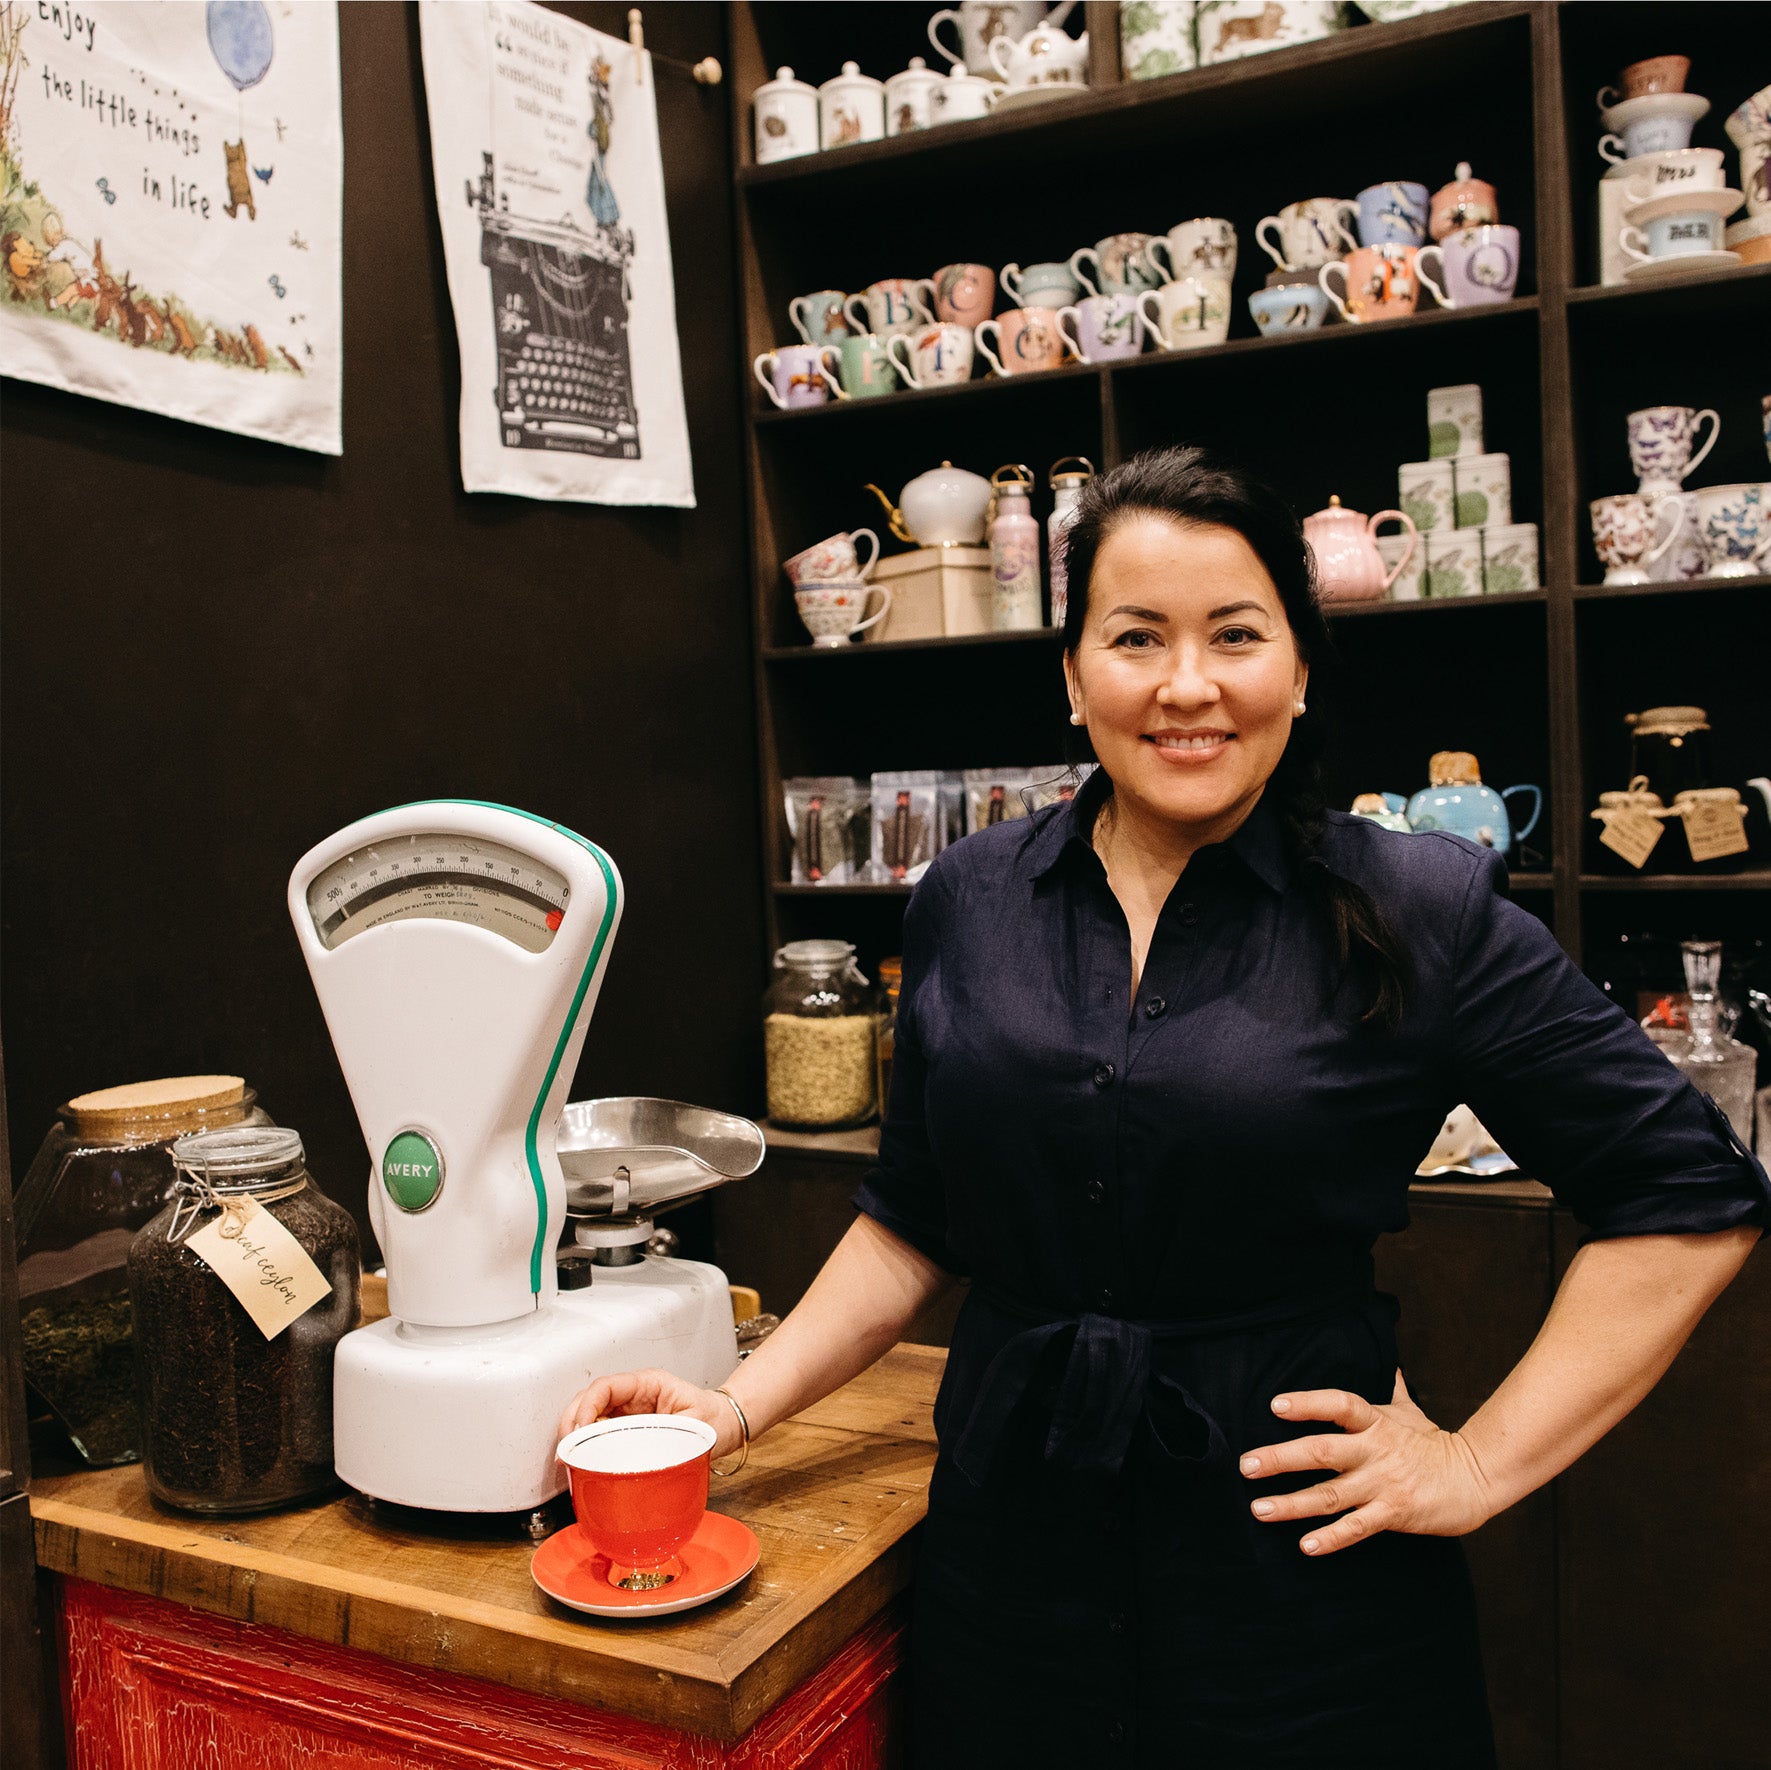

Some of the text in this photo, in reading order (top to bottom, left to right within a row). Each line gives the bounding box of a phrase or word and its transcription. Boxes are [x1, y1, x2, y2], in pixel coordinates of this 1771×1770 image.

[42, 64, 201, 156] the little things
[143, 167, 211, 220] in life
[459, 855, 469, 863] 200
[484, 862, 494, 870] 150
[535, 879, 543, 887] 50
[563, 887, 569, 898] 0
[366, 920, 377, 929] MADE
[383, 908, 404, 920] ENGLAND
[386, 1162, 434, 1179] AVERY
[257, 1258, 297, 1305] ceylon
